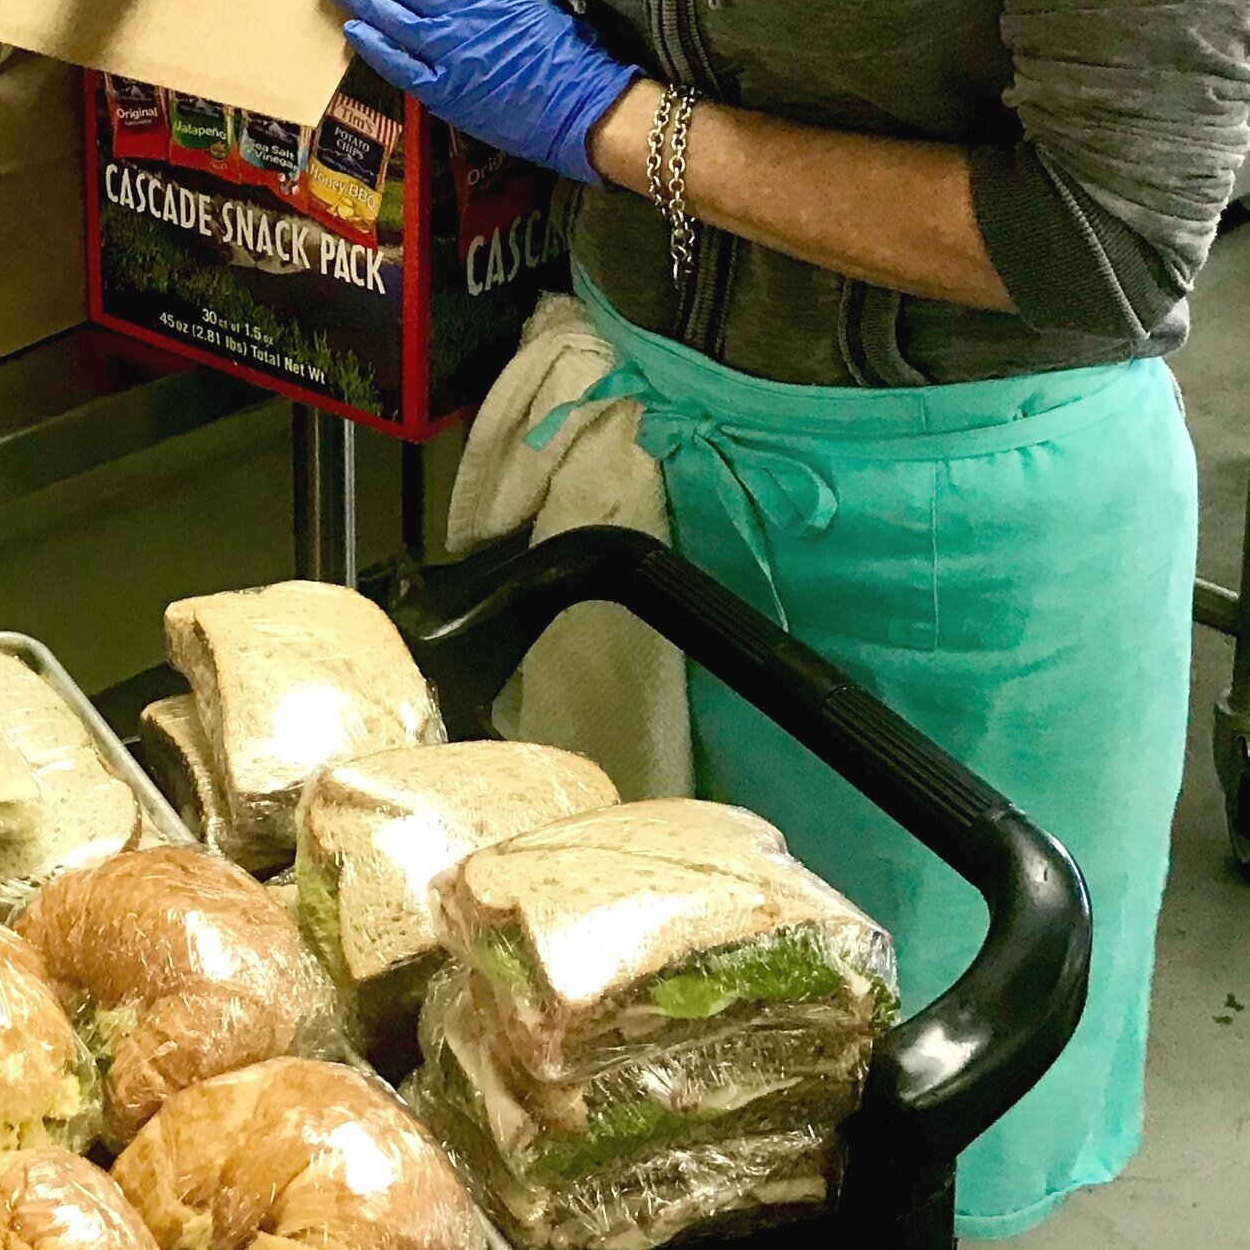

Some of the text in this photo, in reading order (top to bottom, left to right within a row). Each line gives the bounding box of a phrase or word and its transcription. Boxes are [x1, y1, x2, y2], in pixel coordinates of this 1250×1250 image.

[116, 107, 158, 120] Original
[342, 106, 375, 134] Tim's
[335, 126, 370, 152] POTATO
[336, 138, 364, 160] CHIPS
[254, 150, 297, 171] Vinegar
[271, 145, 295, 161] Salt
[309, 164, 346, 194] Honey
[349, 183, 375, 210] BBQ
[106, 164, 386, 295] CASCADE SNACK PACK
[202, 308, 217, 325] 30
[244, 323, 261, 341] 1.5
[192, 324, 221, 345] (2.81
[225, 336, 248, 356] lbs)
[250, 344, 280, 368] Total
[284, 356, 305, 377] Net
[308, 365, 326, 385] Wt
